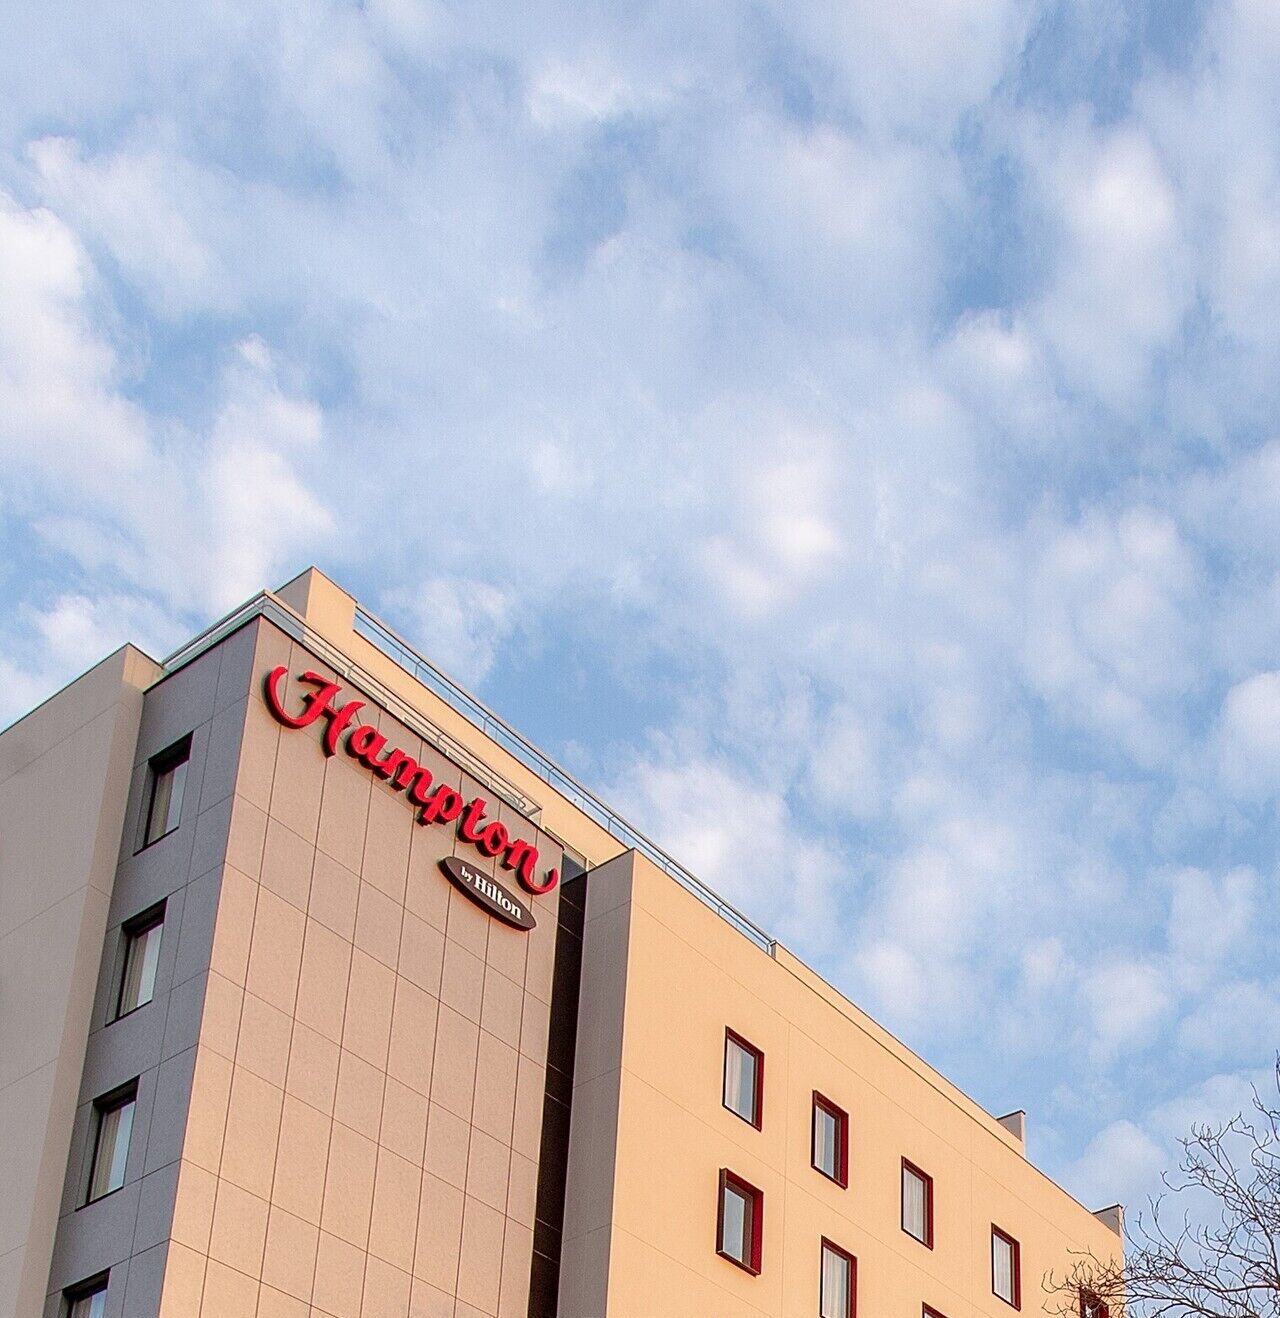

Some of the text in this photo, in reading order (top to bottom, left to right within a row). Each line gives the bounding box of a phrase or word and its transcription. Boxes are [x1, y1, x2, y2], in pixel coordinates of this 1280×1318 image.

[265, 666, 559, 895] Hampton
[461, 866, 522, 920] by Hilton
